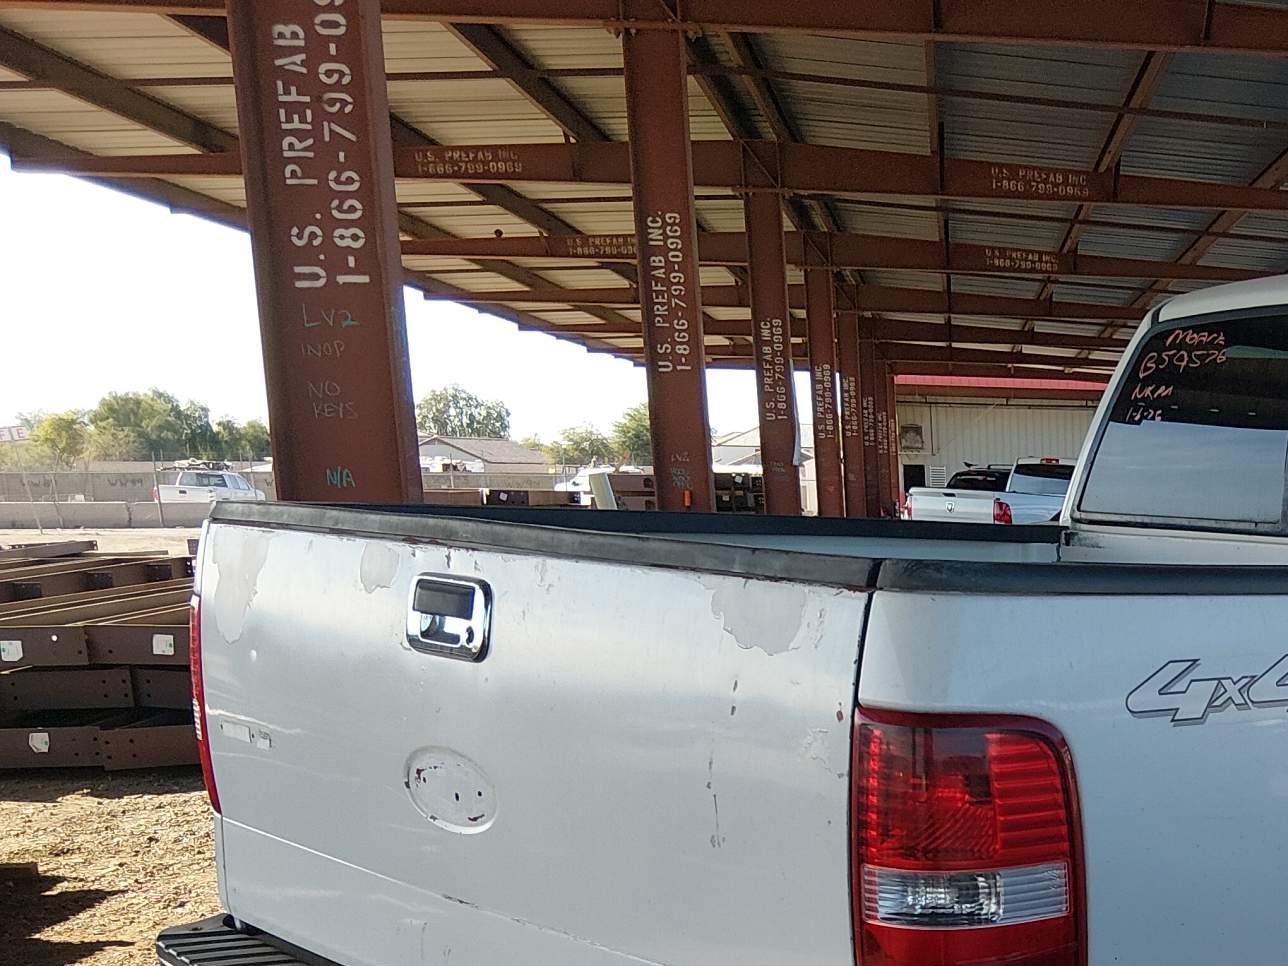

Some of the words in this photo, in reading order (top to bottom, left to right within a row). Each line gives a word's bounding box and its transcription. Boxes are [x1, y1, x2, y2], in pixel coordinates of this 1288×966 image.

[272, 24, 319, 185] PREFAB
[313, 0, 371, 285] 1-866-799-0
[445, 149, 493, 161] PREFAB
[1019, 168, 1063, 184] PREFAB
[290, 212, 328, 288] U.S.
[647, 211, 665, 246] INC.
[650, 255, 670, 327] PREFAB
[665, 212, 692, 371] 1-866-799-0969
[760, 318, 772, 341] INC.
[657, 337, 674, 373] U.S.
[762, 346, 775, 393] PREFAB
[772, 319, 788, 420] 1-866-799-0969
[765, 397, 777, 421] U.S.
